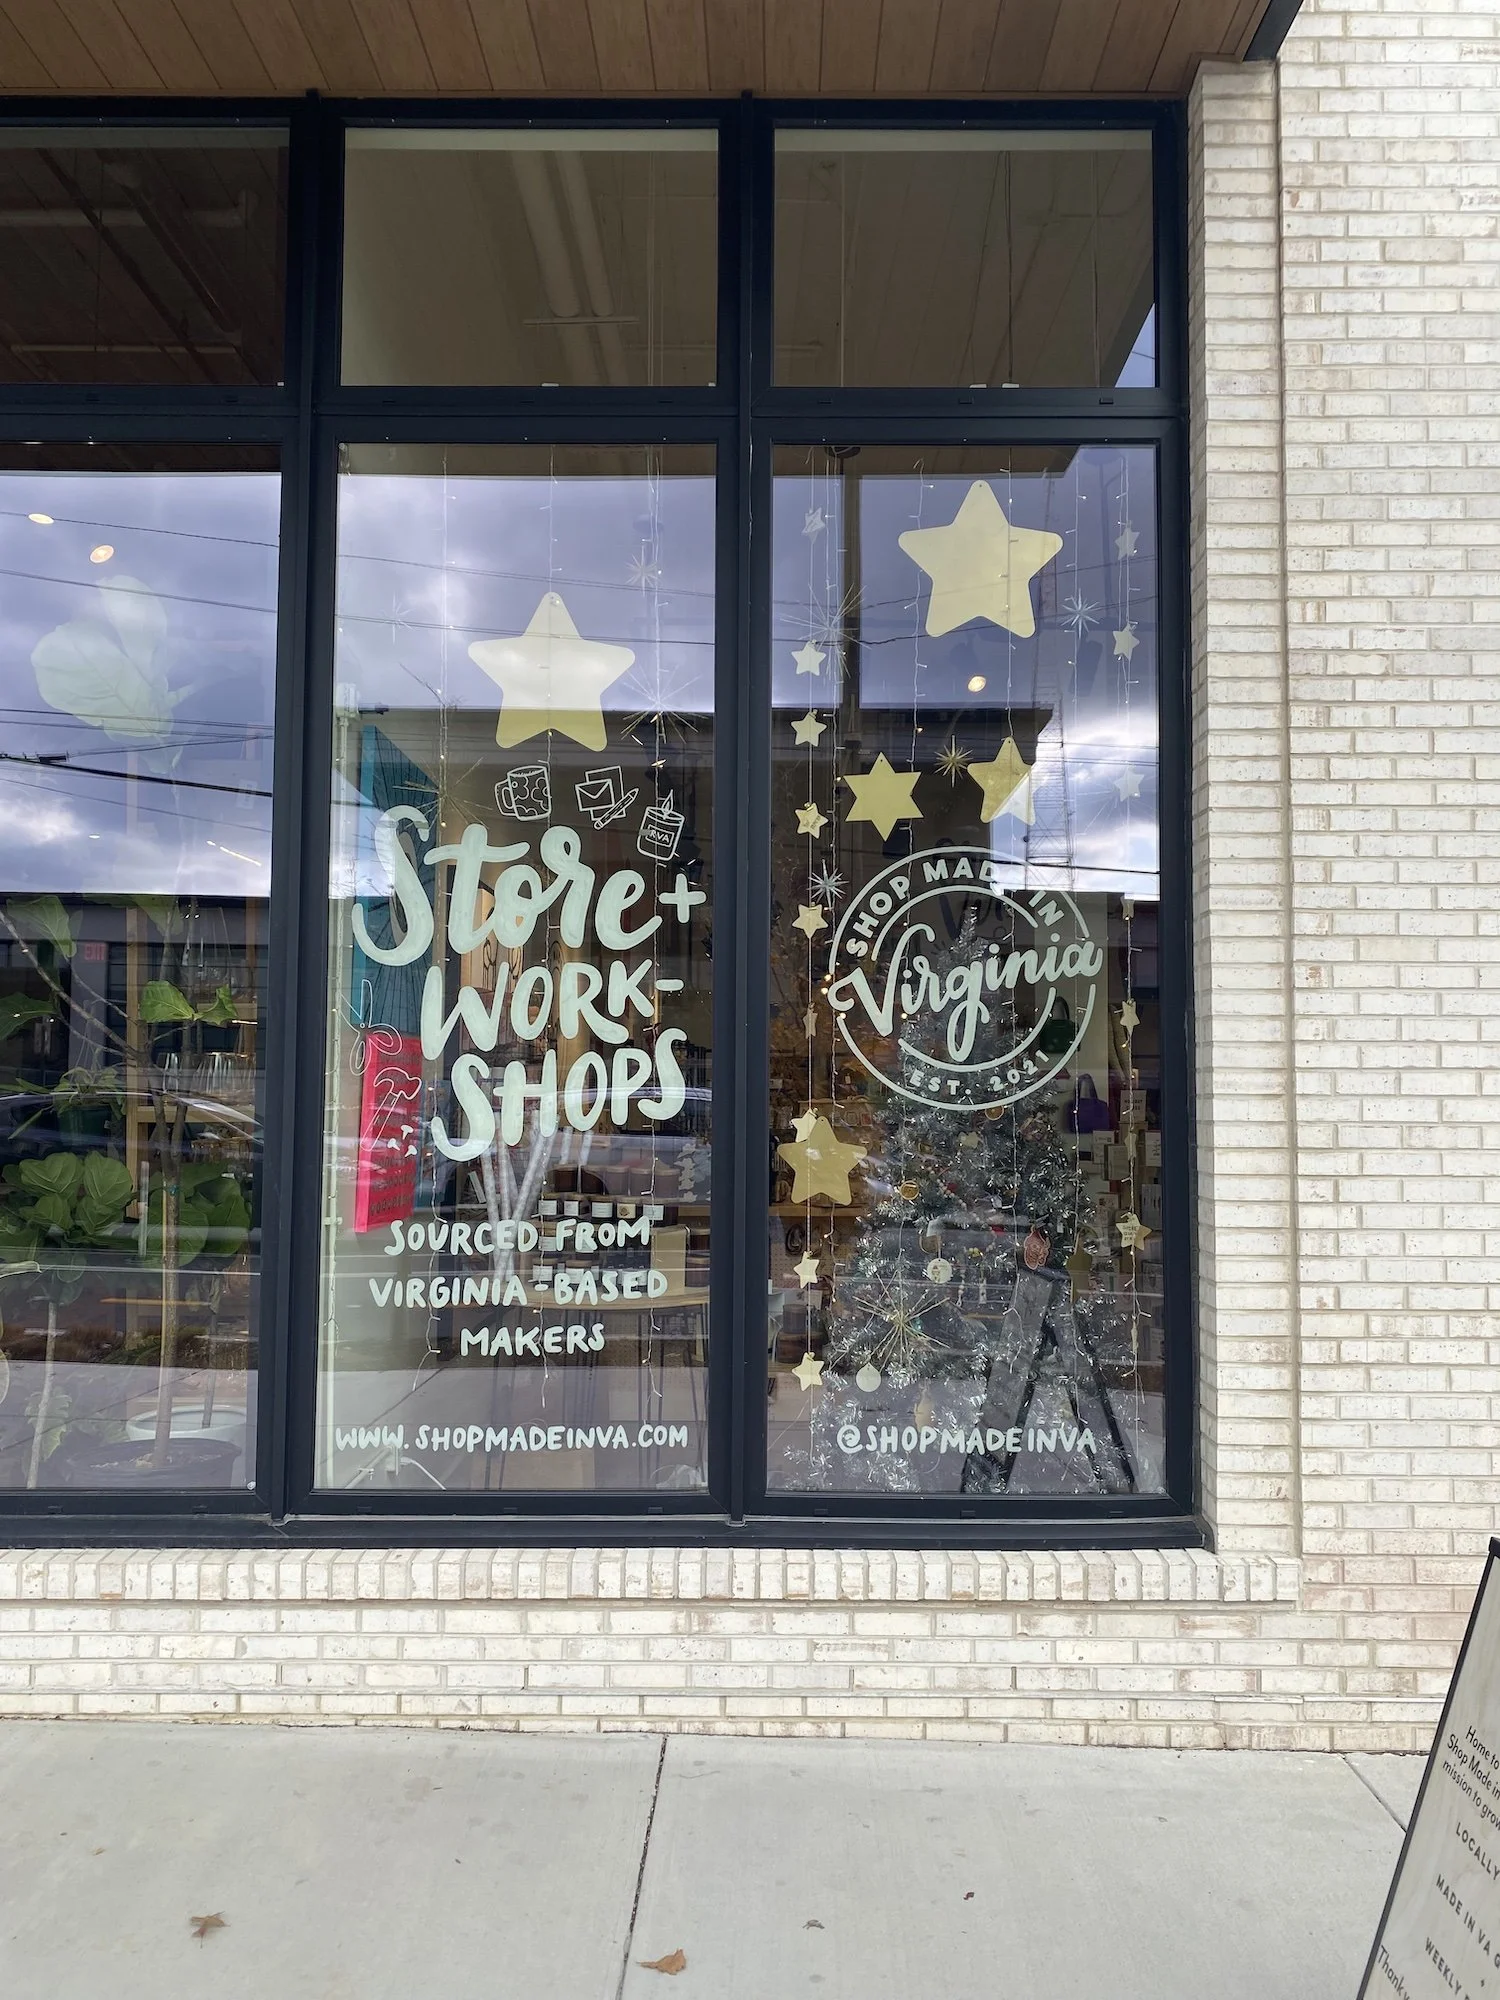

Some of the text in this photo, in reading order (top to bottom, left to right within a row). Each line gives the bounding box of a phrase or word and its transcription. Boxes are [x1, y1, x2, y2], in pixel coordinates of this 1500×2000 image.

[650, 829, 670, 843] RVA
[845, 857, 1065, 958] SHOP MAD IN
[827, 923, 1103, 1062] Virginia
[431, 1028, 688, 1162] SHOPS
[910, 1049, 1050, 1096] EST. 2021
[384, 1215, 651, 1256] SOURCED FROM
[459, 1322, 606, 1358] MAKERS
[836, 1425, 1097, 1455] @SHOPMADEINVA
[1447, 1733, 1468, 1767] Shop
[1468, 1755, 1493, 1791] Made
[1465, 1725, 1500, 1770] Home to
[1442, 1760, 1473, 1797] mission
[1472, 1790, 1482, 1807] to
[1456, 1822, 1500, 1881] LOCALLY
[1436, 1873, 1491, 1956] MADE IN VA
[1378, 1944, 1405, 1997] Thank
[1425, 1936, 1462, 1996] WEEKLY
